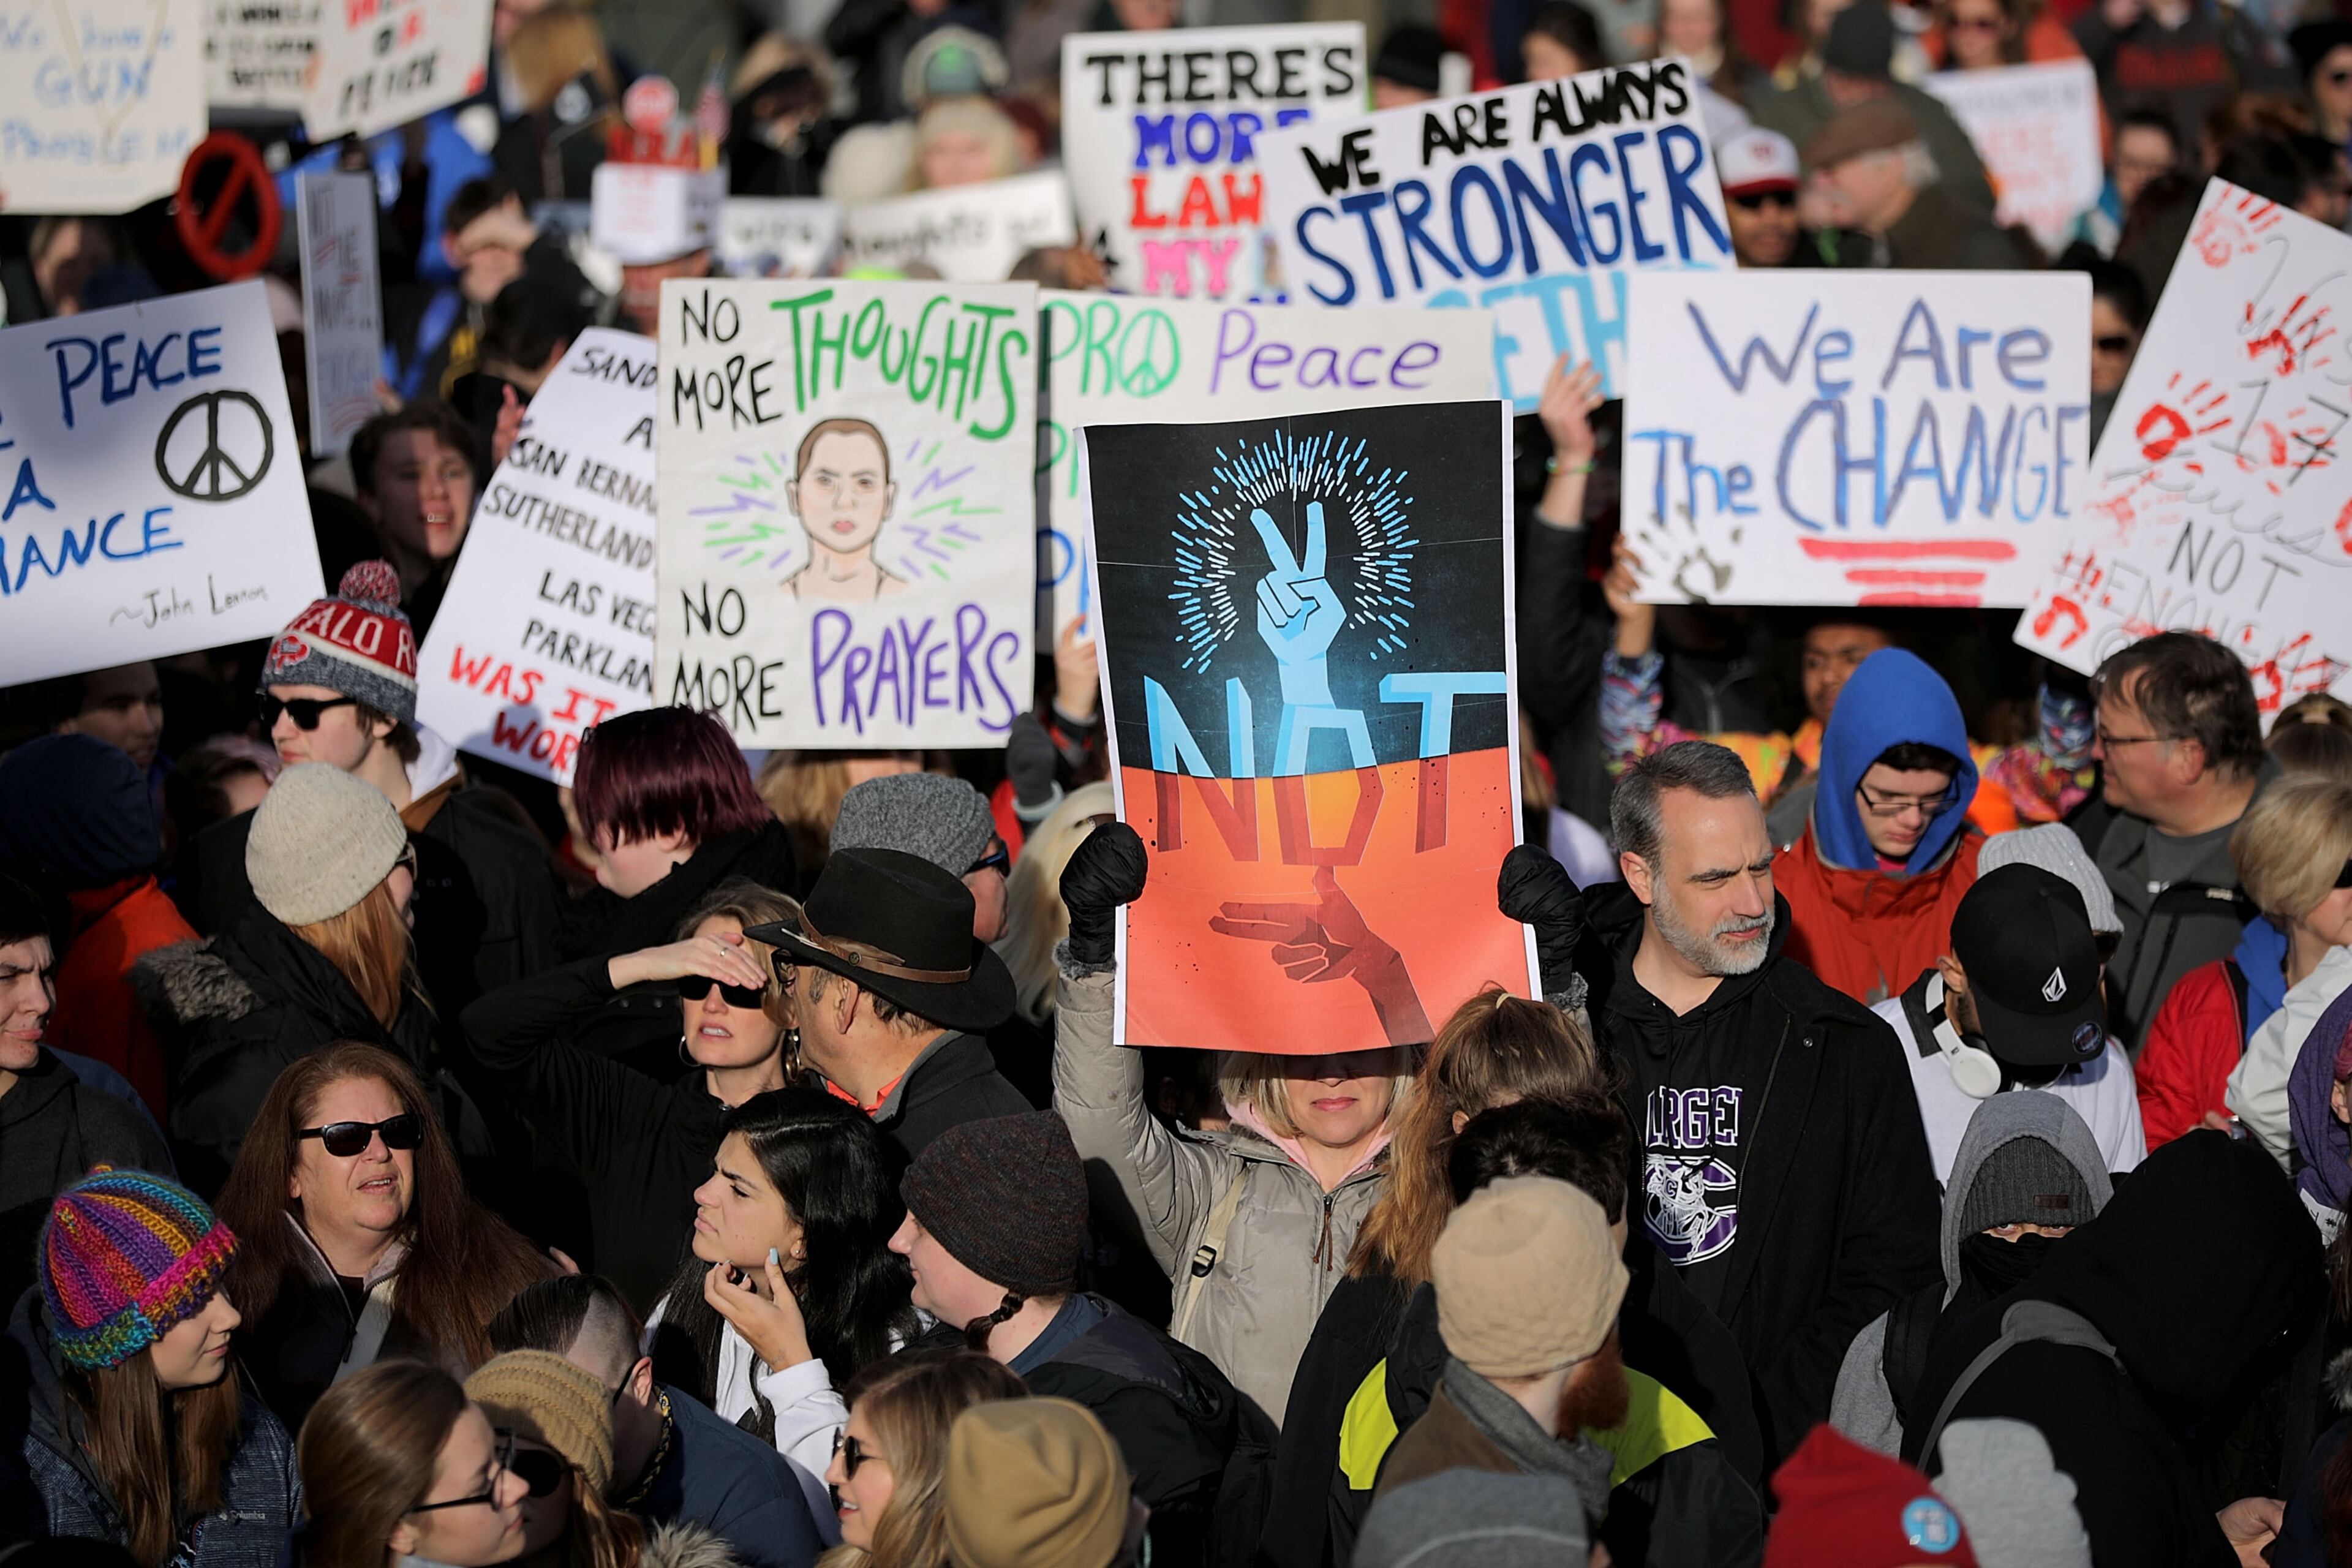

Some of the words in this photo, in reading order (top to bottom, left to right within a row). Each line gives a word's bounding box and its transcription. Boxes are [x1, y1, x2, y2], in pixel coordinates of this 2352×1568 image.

[34, 54, 157, 109] GUN
[1135, 109, 1310, 168] MOR
[1302, 129, 1380, 195] WE
[1423, 98, 1509, 165] ARE
[1532, 64, 1688, 142] ALWAYS
[1296, 124, 1732, 306] STRONGER
[1143, 239, 1239, 295] MY
[681, 290, 740, 345] NO
[1209, 307, 1442, 396] Peace
[1687, 296, 1854, 398] We
[1881, 298, 2051, 392] Are
[45, 327, 222, 428] PEACE
[573, 347, 657, 389] SAND
[674, 354, 783, 430] MORE
[769, 288, 1029, 441] THOUGHTS
[2, 458, 56, 521] A
[508, 436, 568, 481] SAN
[576, 453, 657, 518] BERNA
[1631, 429, 1760, 527] The
[1776, 396, 2091, 532] CHANGE
[483, 484, 655, 572] SUTHERLAND
[2167, 521, 2303, 612] NOT
[538, 570, 603, 616] LAS
[610, 594, 656, 642] VEG
[681, 581, 746, 638] NO
[448, 645, 545, 707] WAS
[552, 687, 617, 729] IT
[521, 617, 654, 696] PARKLAN
[673, 652, 785, 735] MORE
[812, 603, 1020, 734] PRAYERS
[492, 710, 581, 771] WOR
[1144, 671, 1507, 866] NOT
[1645, 1085, 1743, 1149] RGE
